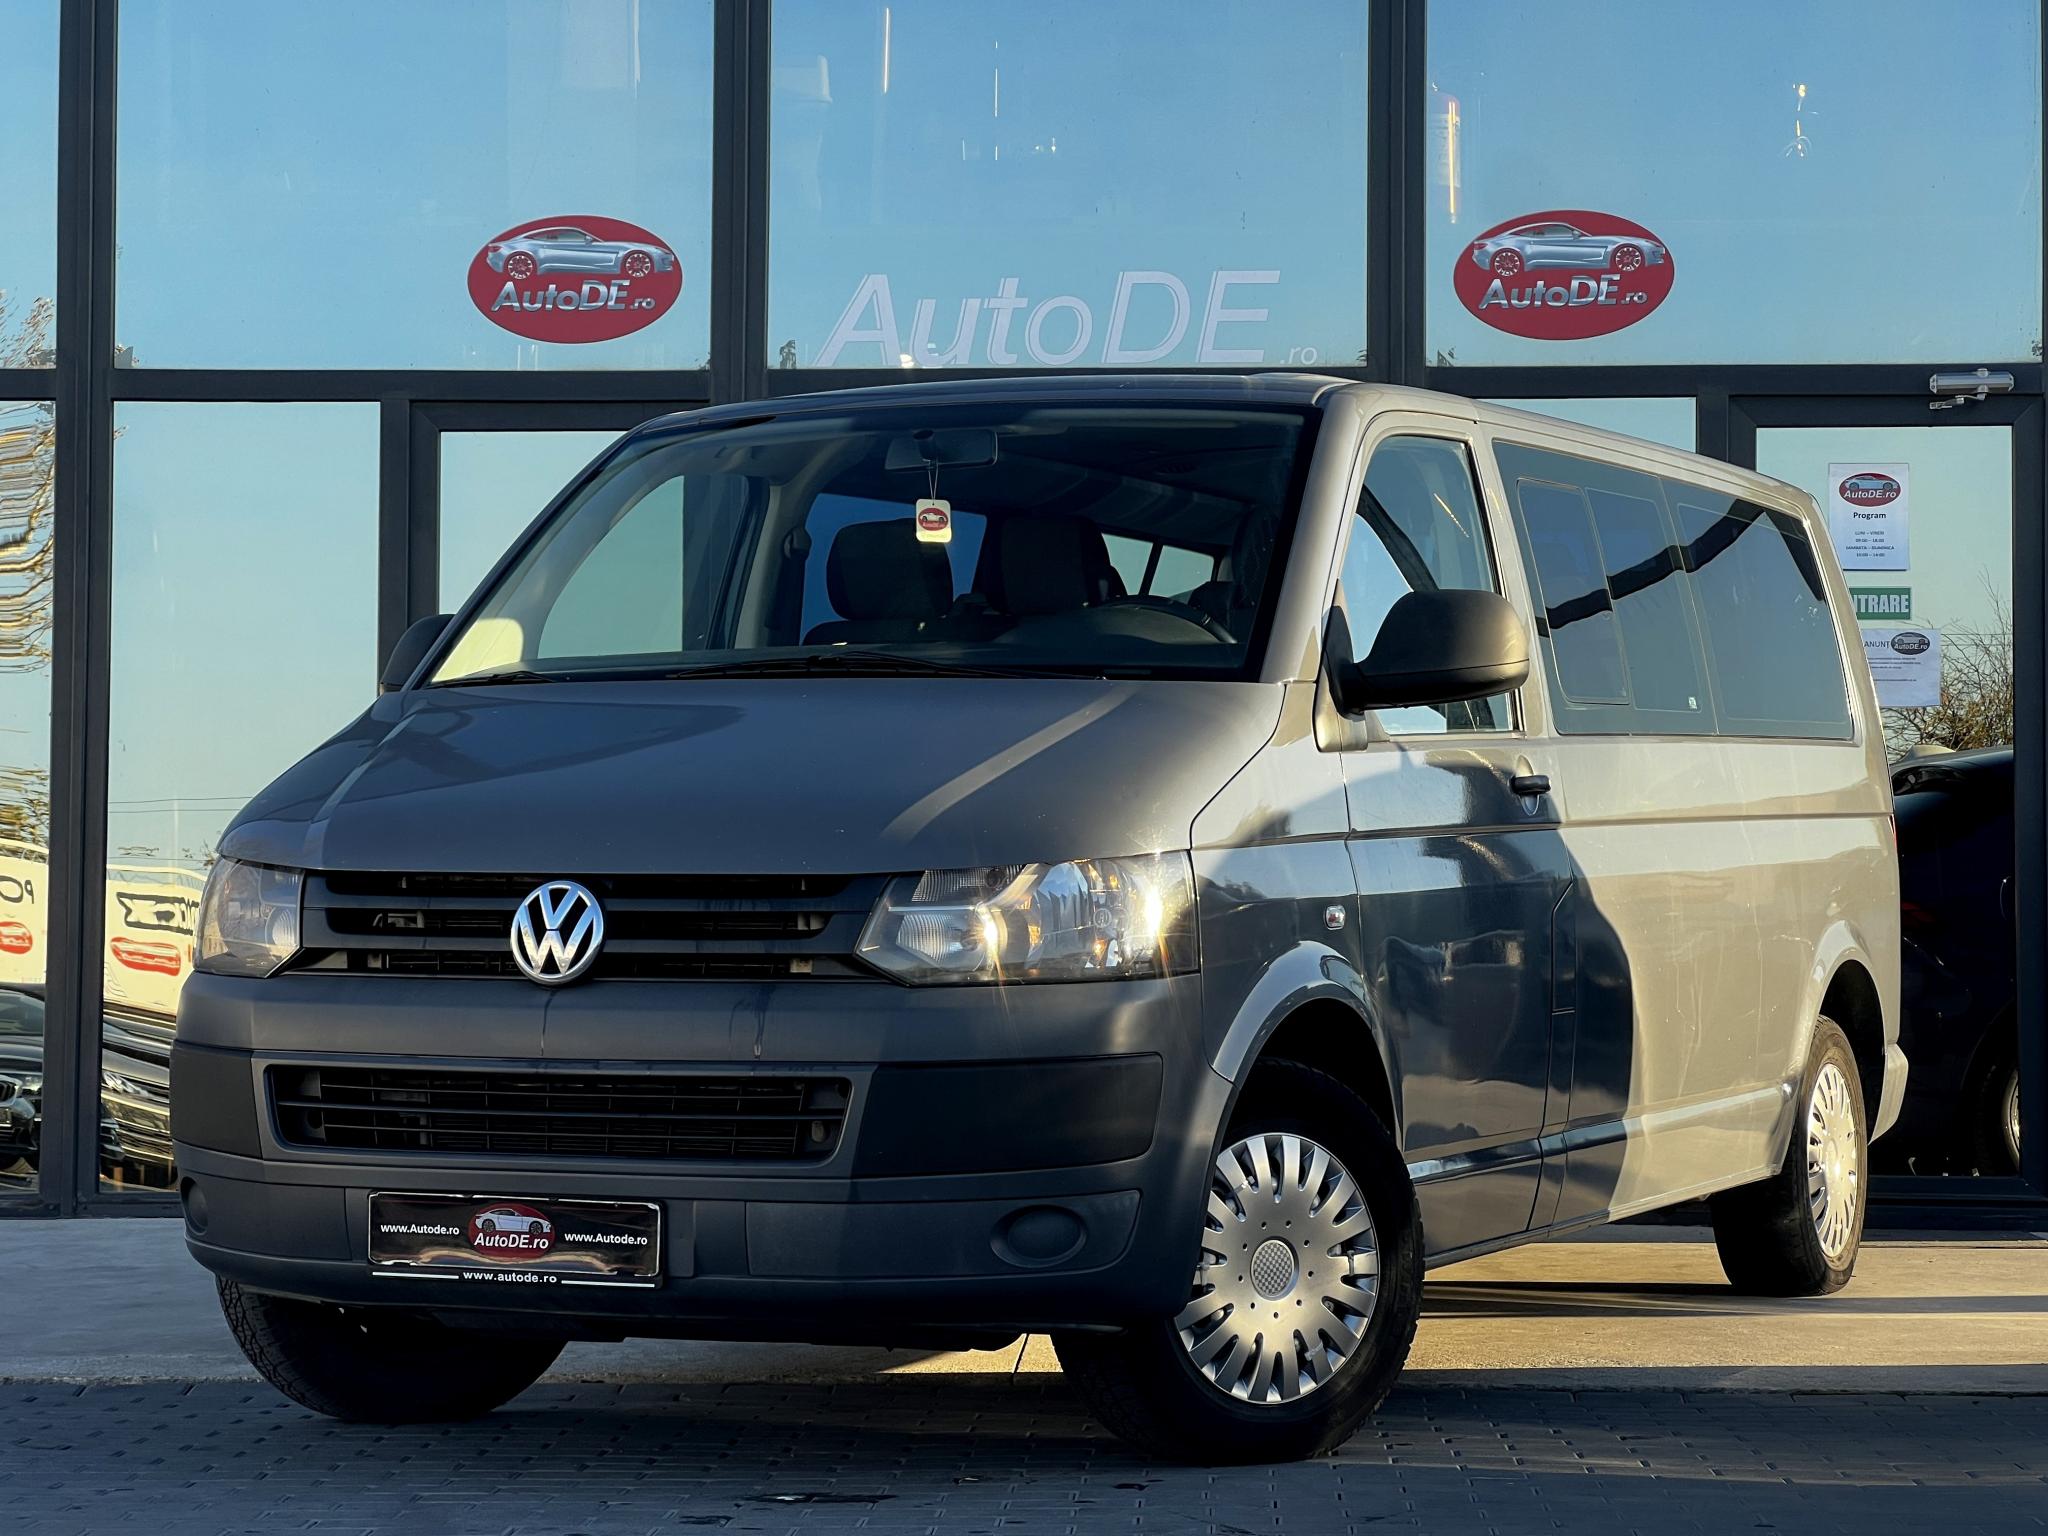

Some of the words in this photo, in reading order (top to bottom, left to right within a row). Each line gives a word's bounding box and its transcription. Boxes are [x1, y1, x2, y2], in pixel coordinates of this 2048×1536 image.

[1844, 489, 1897, 498] AutoDE.ro
[1853, 512, 1887, 521] Program
[380, 1224, 460, 1235] www.Autode.ro
[474, 1232, 549, 1249] AutoDE.ro
[564, 1233, 648, 1246] www.Autode.ro
[462, 1271, 558, 1283] www.autode.ro
